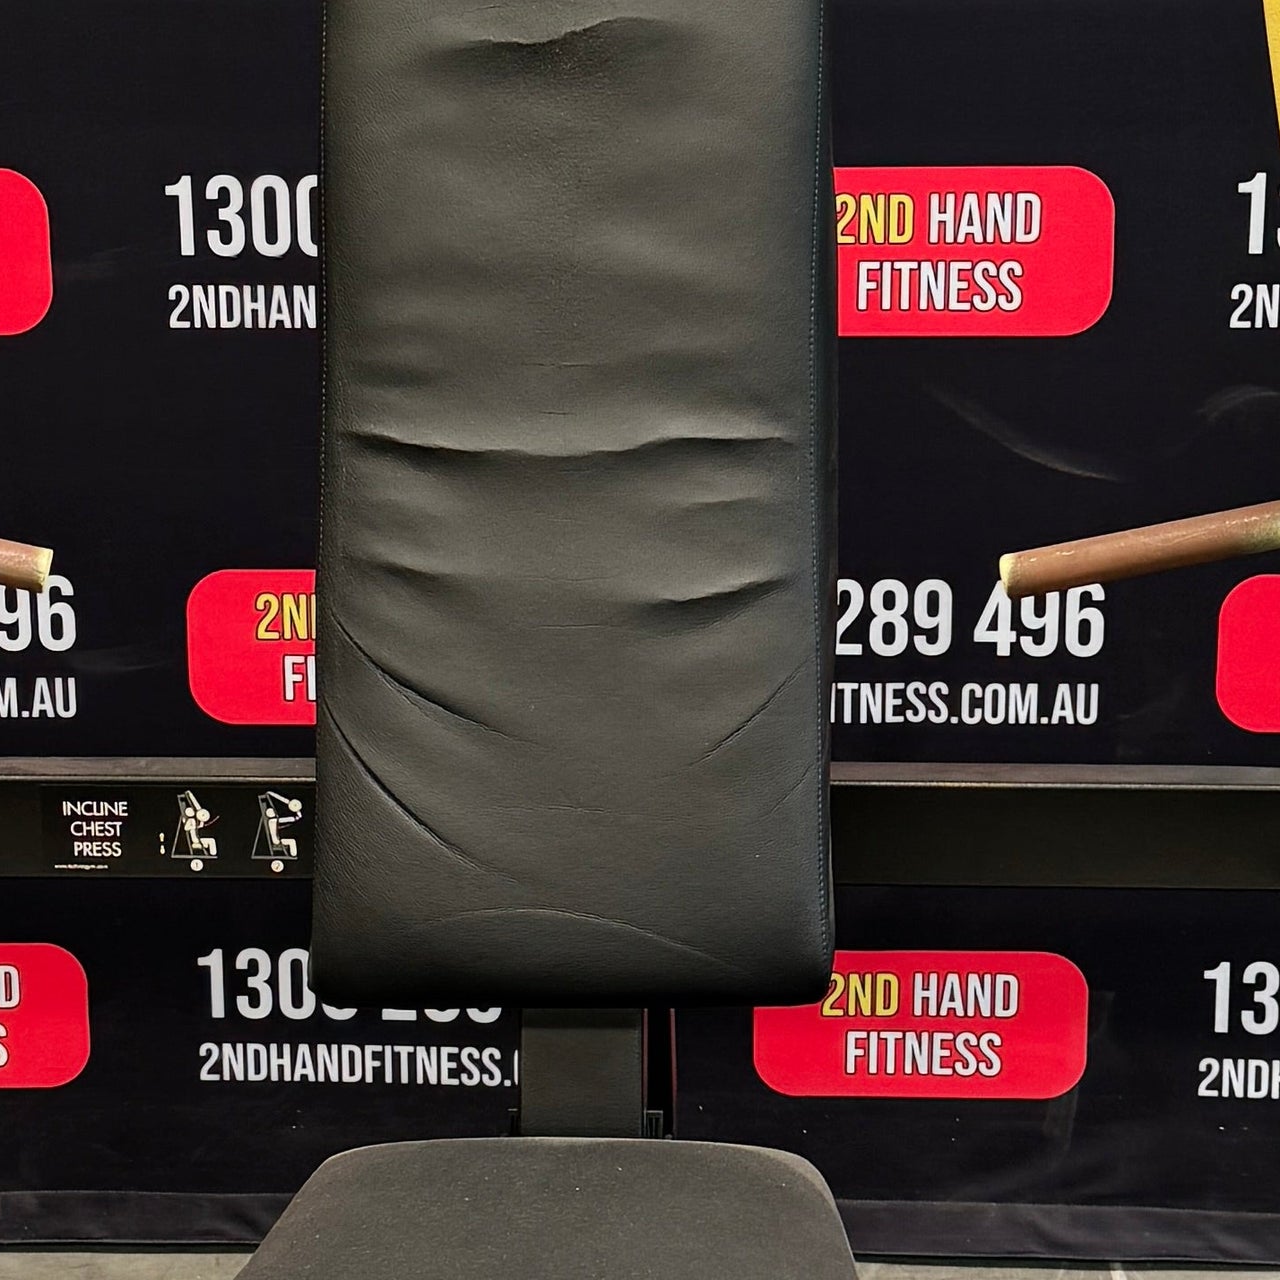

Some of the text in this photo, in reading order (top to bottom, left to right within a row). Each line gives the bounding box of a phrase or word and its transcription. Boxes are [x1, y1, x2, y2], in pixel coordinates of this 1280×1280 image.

[836, 193, 1040, 243] 2ND HAND
[858, 261, 1022, 310] FITNESS
[257, 594, 316, 639] 2N
[836, 579, 1106, 658] 289 496
[62, 801, 128, 817] INCLINE
[71, 821, 122, 836] CHEST
[74, 842, 121, 857] PRESS
[198, 948, 357, 1020] 130
[823, 973, 1018, 1017] 2ND HAND
[200, 1043, 518, 1086] 2NDHANDFITNESS.
[847, 1032, 1001, 1076] FITNESS
